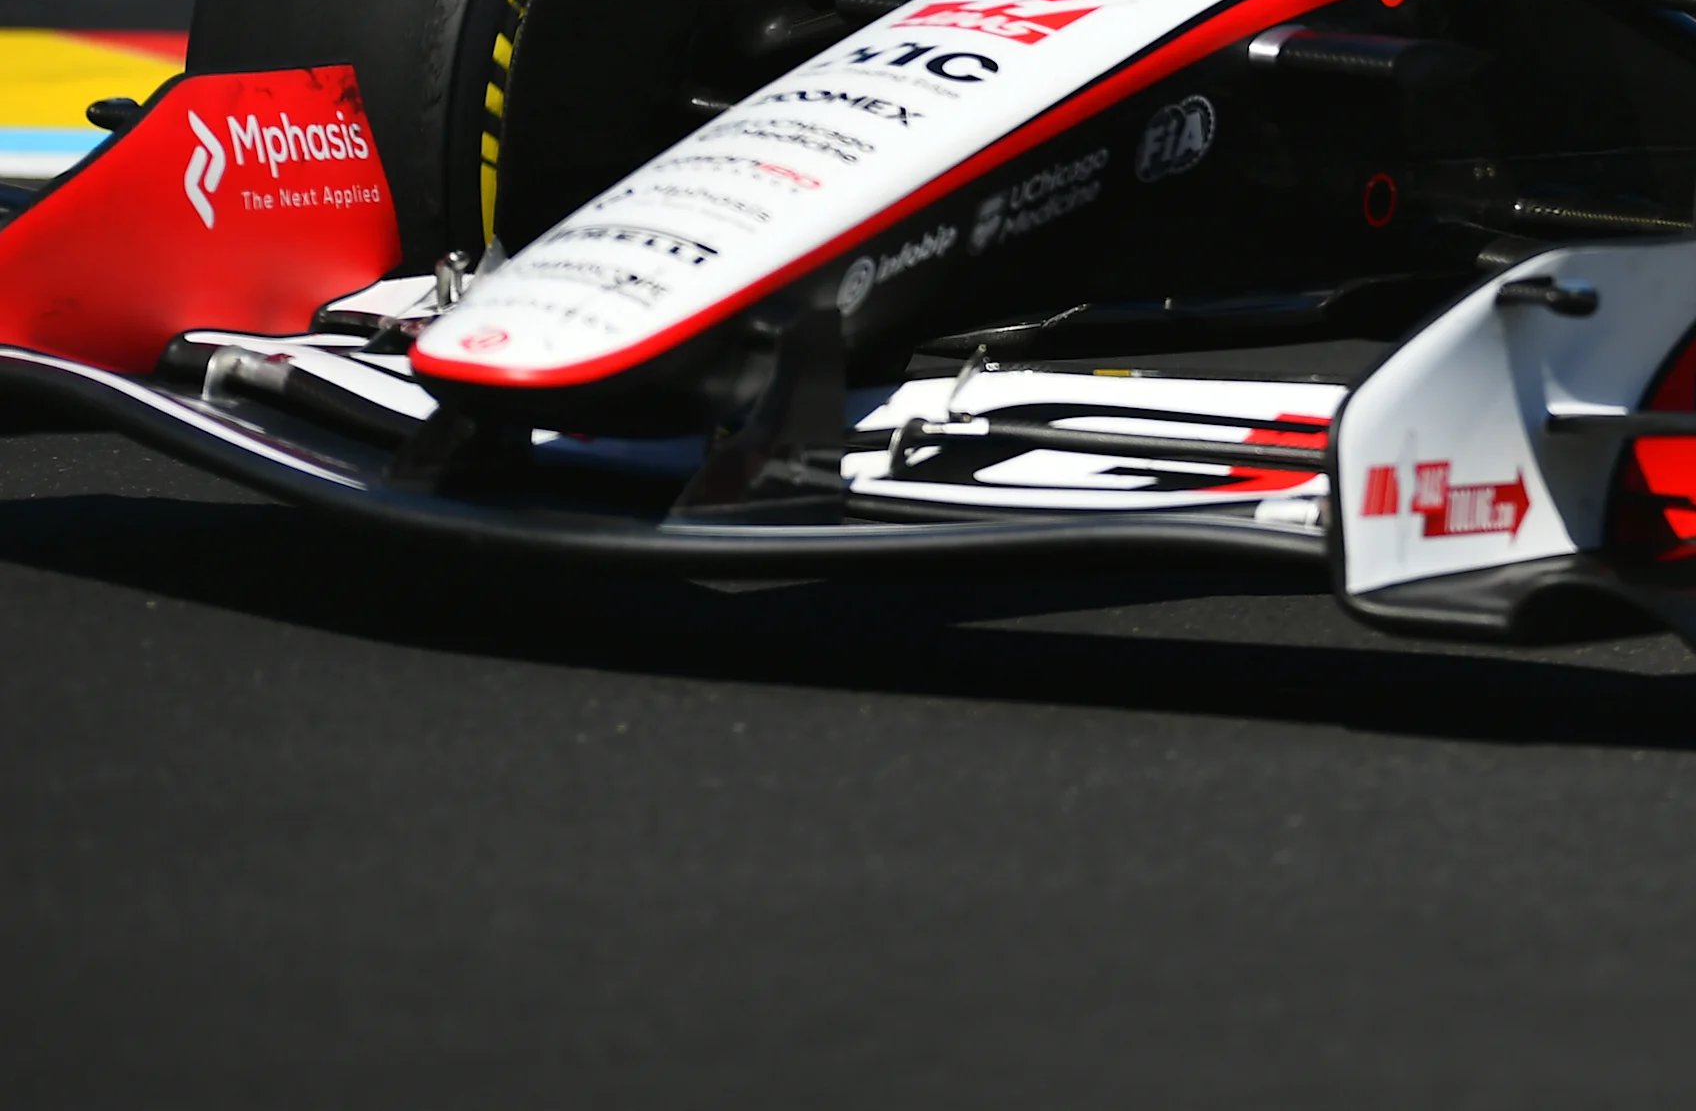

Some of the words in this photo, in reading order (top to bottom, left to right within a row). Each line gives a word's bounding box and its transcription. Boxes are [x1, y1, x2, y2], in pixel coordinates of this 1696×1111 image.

[226, 110, 369, 179] Mphasis
[241, 190, 274, 209] The
[279, 187, 318, 208] Next
[322, 184, 381, 209] Applied
